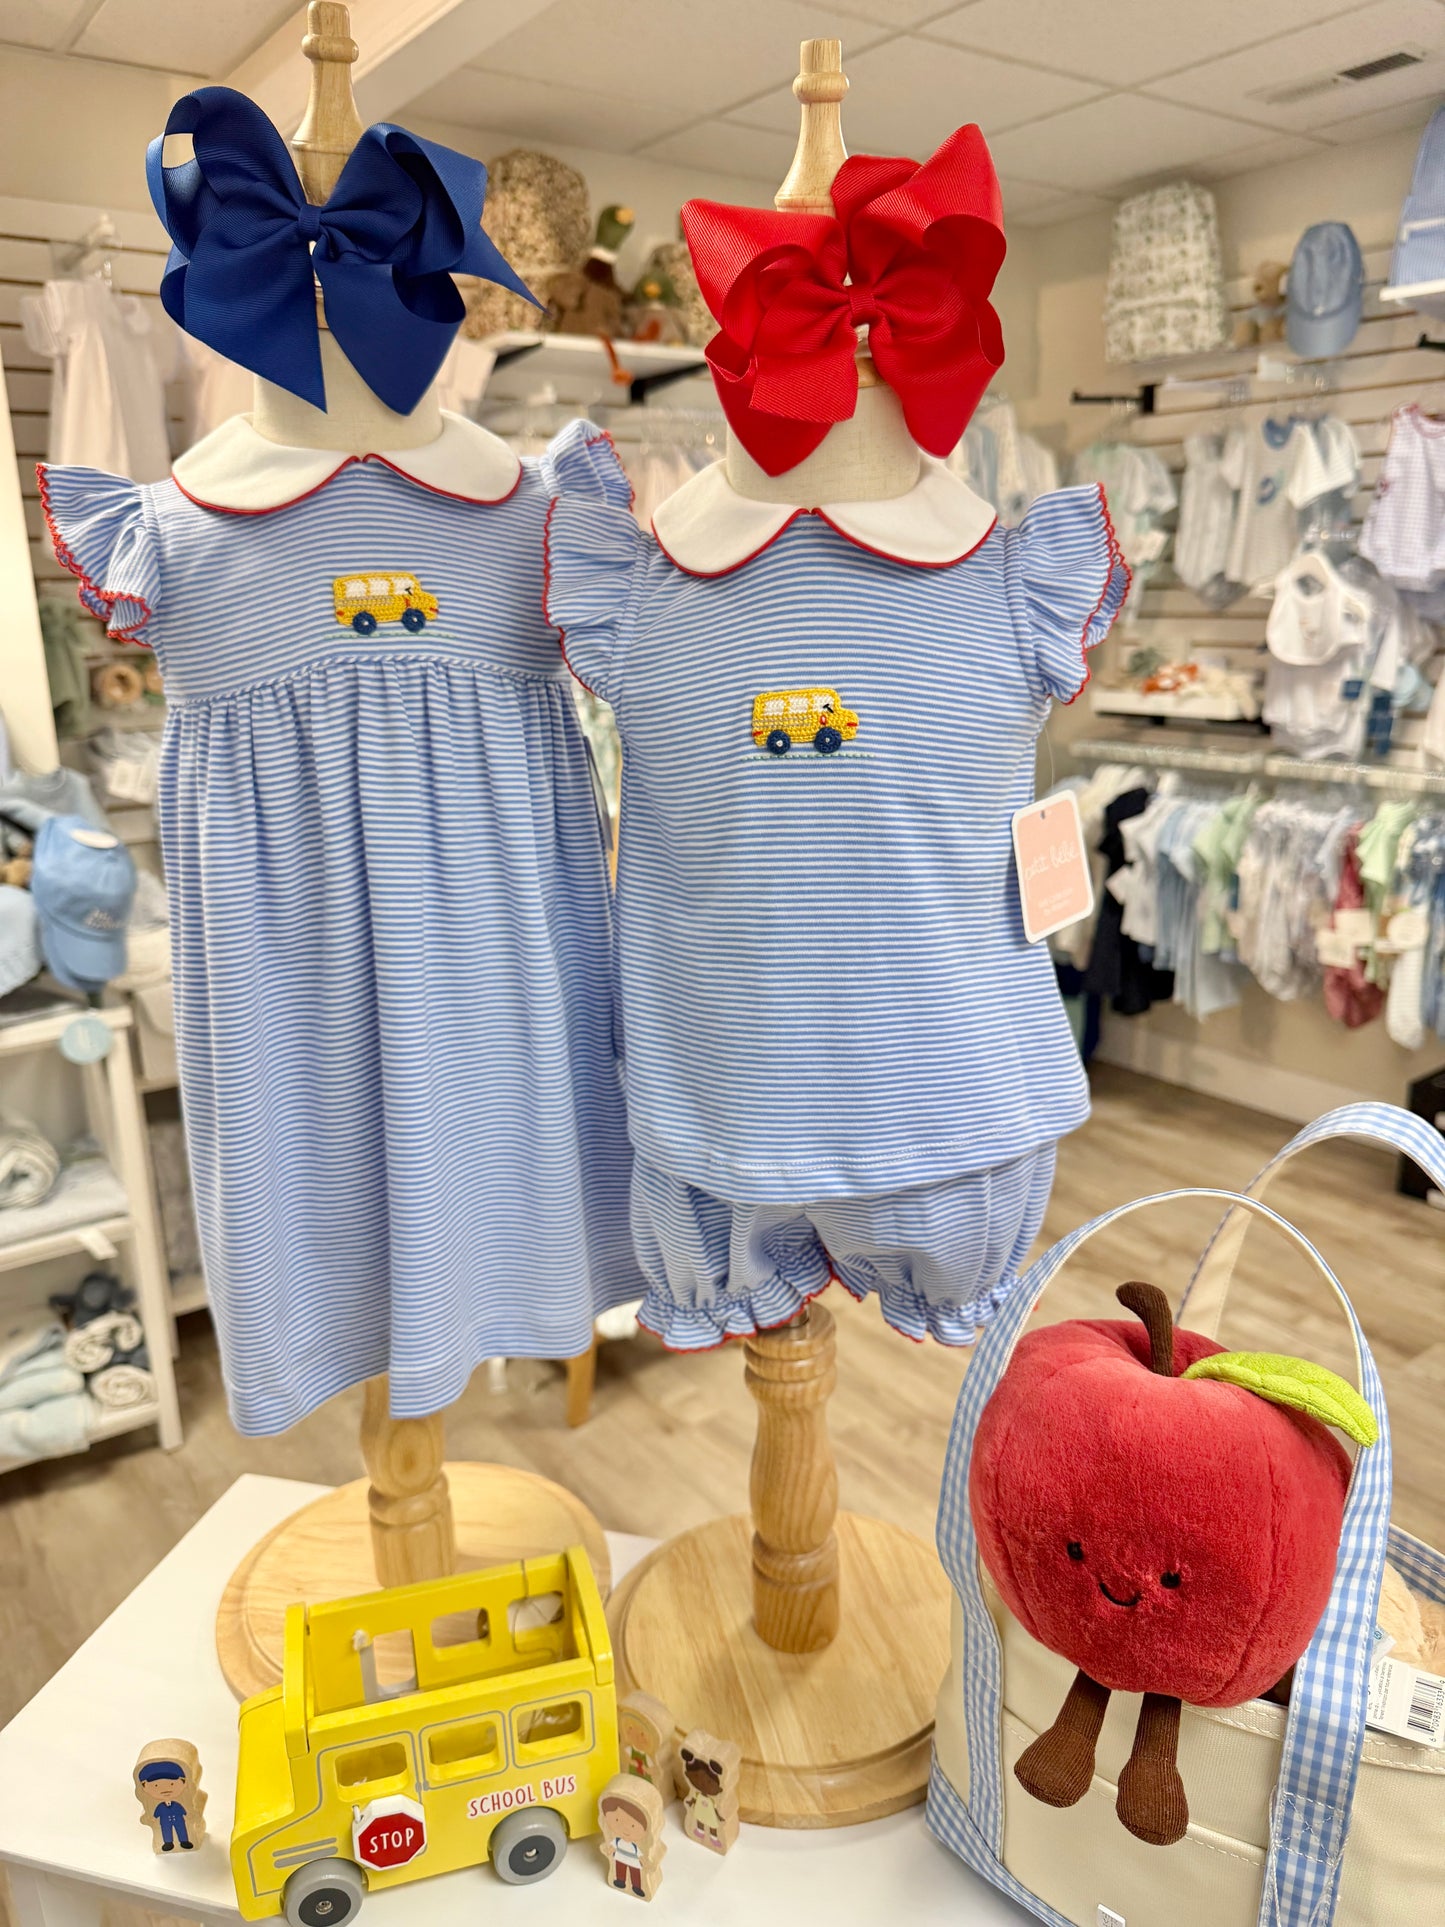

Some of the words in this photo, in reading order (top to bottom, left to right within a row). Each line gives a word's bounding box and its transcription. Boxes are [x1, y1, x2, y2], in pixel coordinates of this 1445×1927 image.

[470, 1785, 536, 1817] SCHOOL
[543, 1775, 575, 1799] BUS
[369, 1827, 415, 1854] STOP
